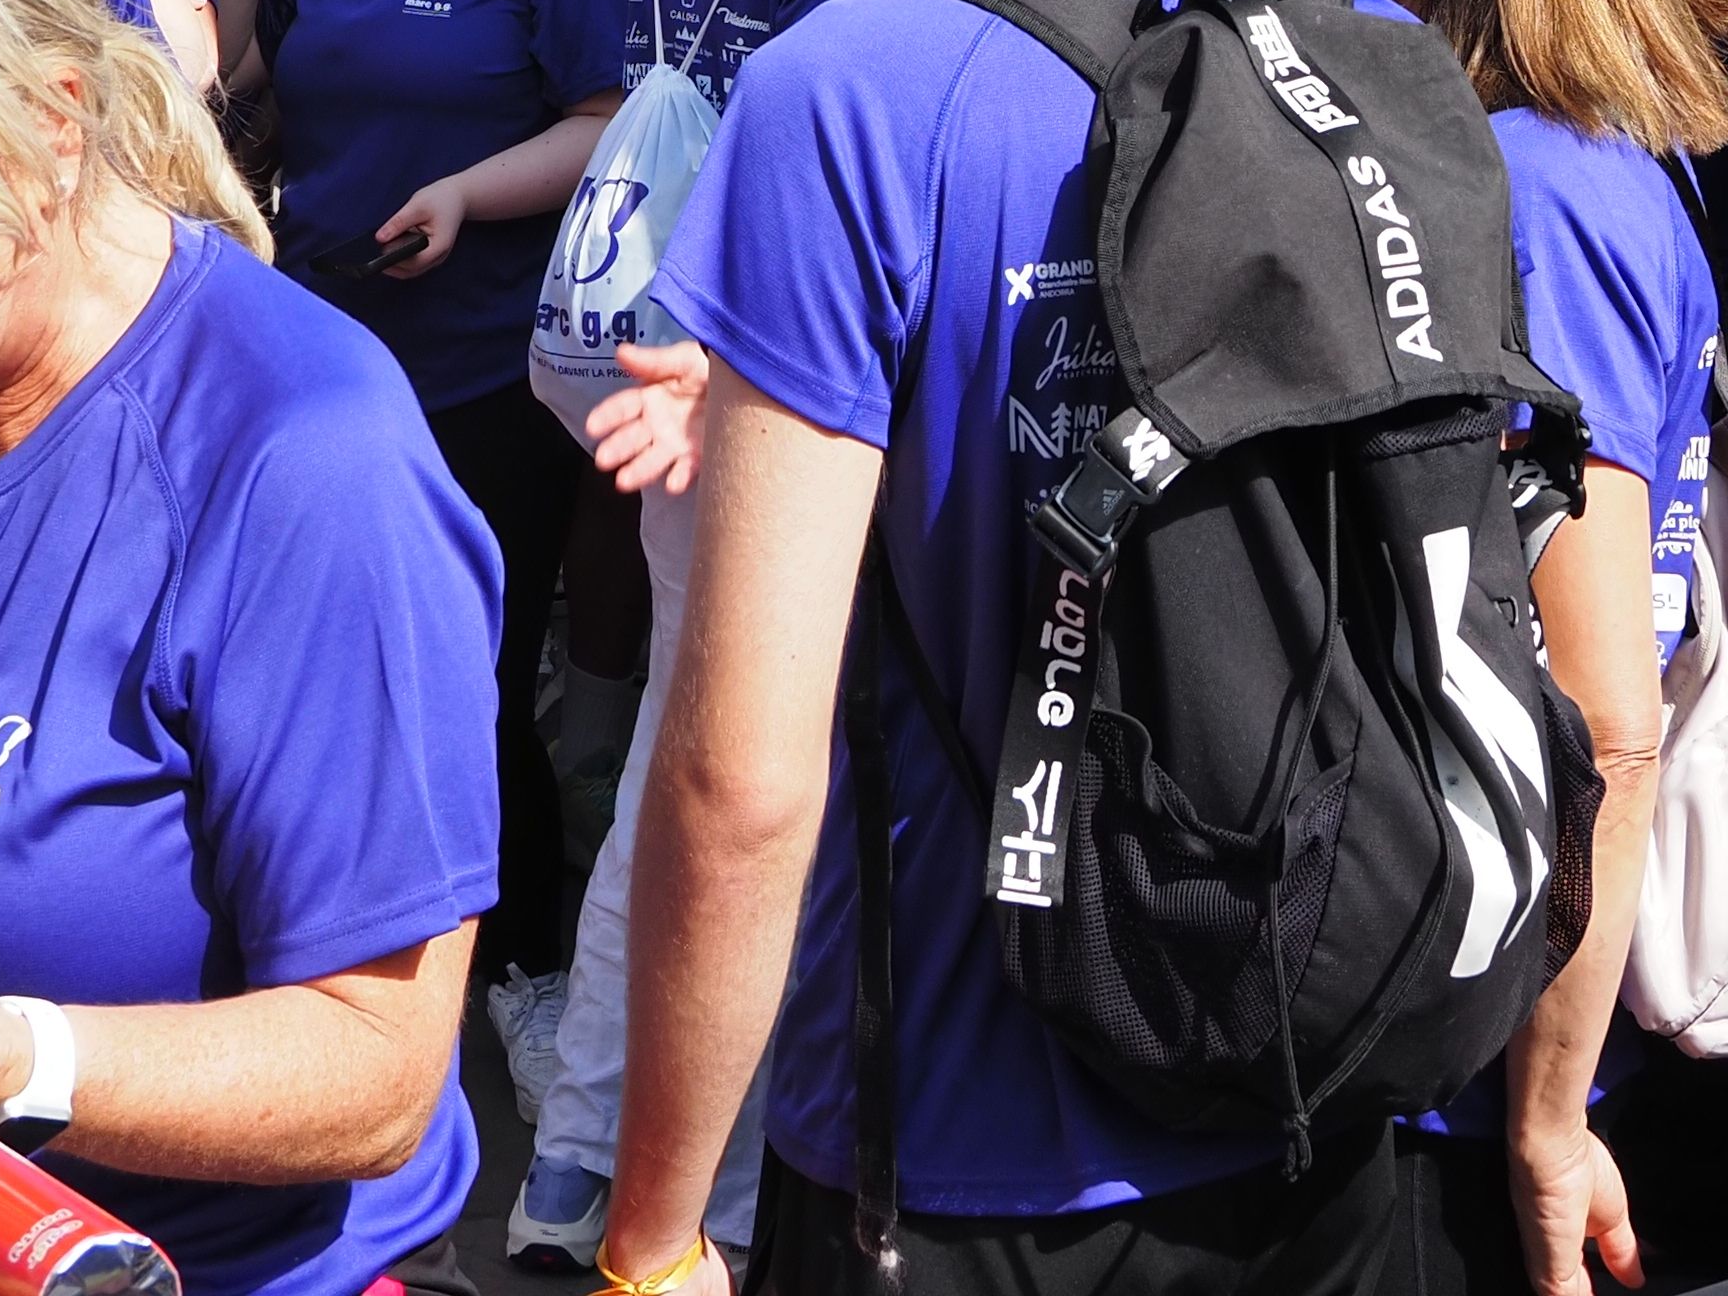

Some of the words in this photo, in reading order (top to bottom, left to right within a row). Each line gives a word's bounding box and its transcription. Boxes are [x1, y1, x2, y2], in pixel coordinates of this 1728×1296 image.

[670, 10, 700, 24] CALDEA
[1035, 259, 1094, 280] GRAND
[1348, 155, 1444, 363] ADIDAS
[536, 303, 569, 337] arc
[582, 310, 644, 348] g.g.
[1035, 316, 1116, 391] Júlia
[558, 365, 590, 378] DAVANT
[592, 367, 604, 378] LA
